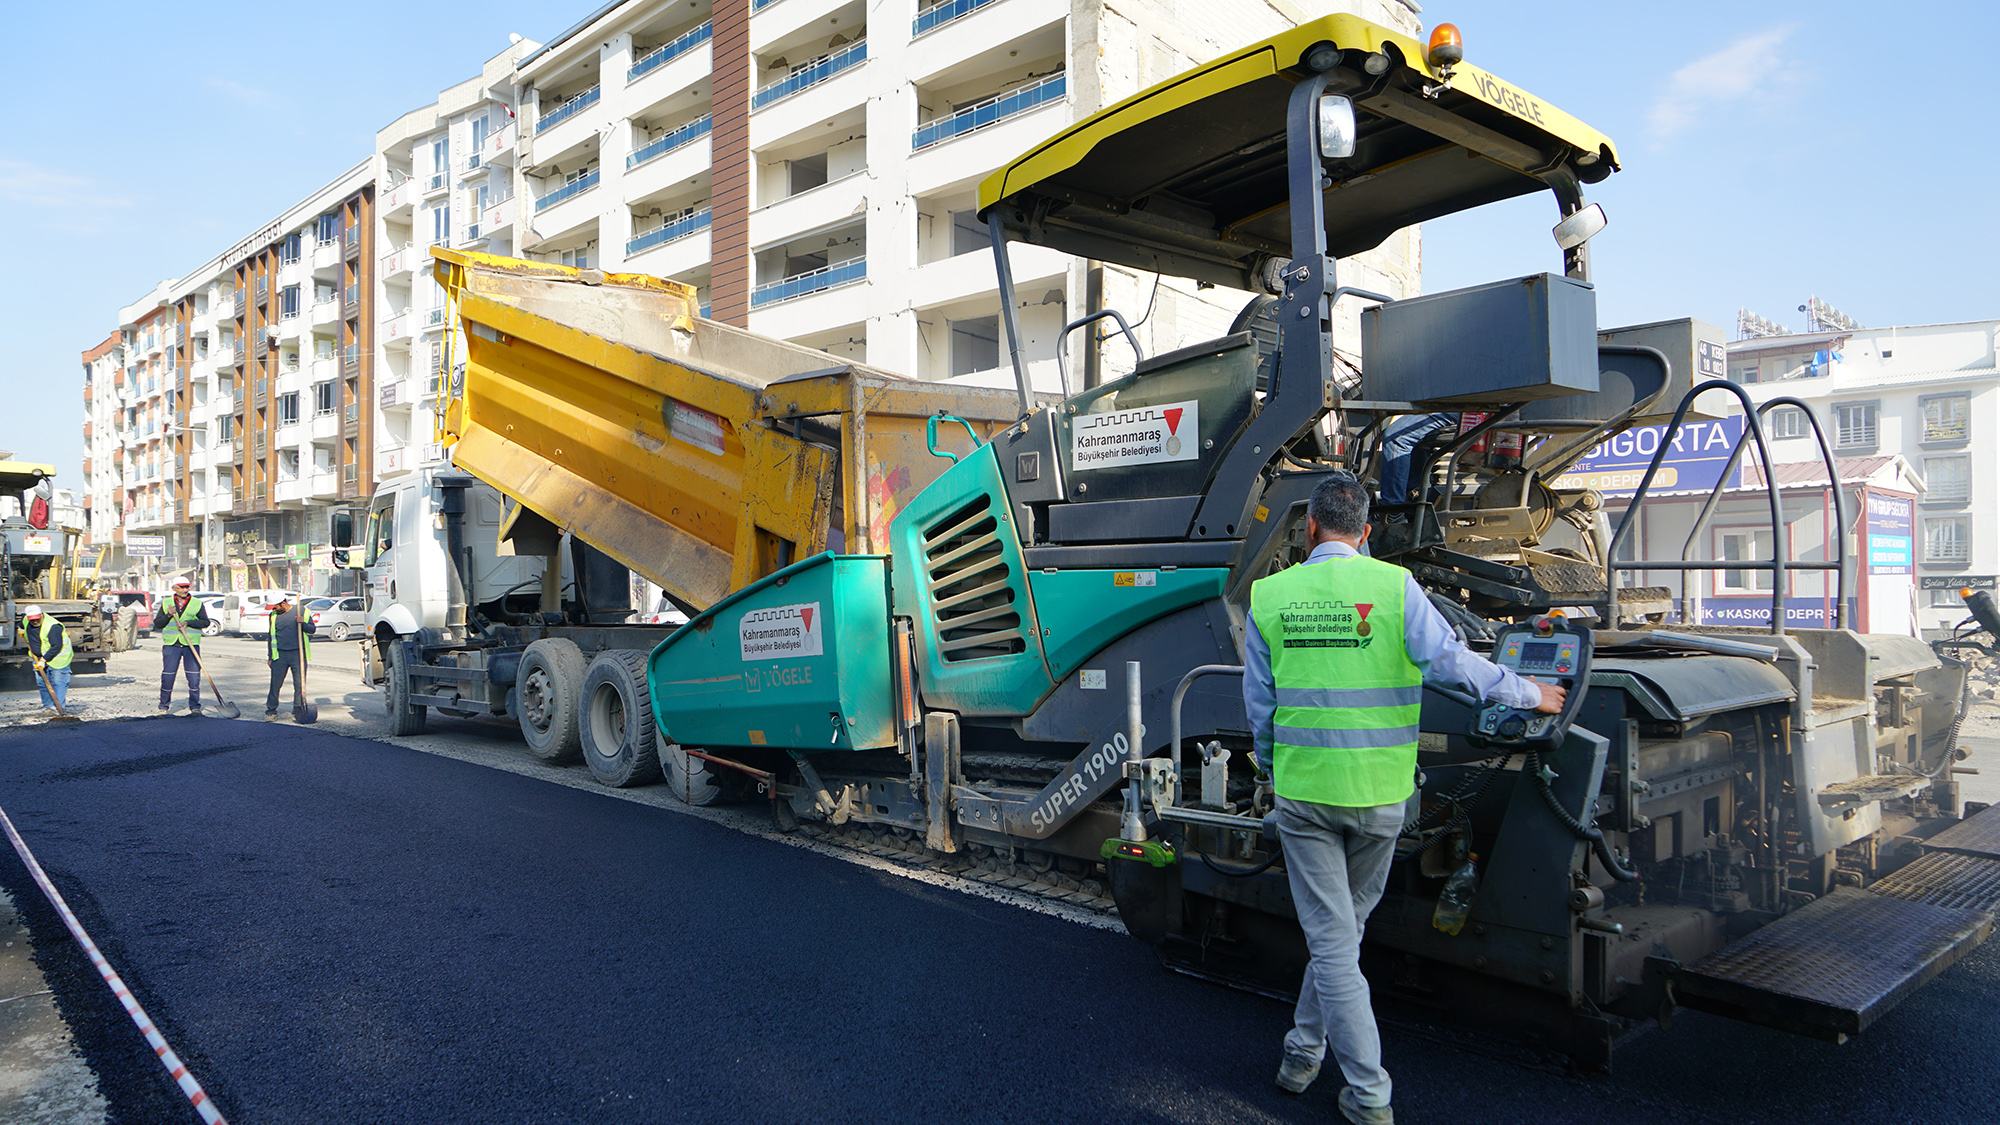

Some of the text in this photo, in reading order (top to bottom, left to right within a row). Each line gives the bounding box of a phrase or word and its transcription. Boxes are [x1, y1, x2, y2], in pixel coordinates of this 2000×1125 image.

[1472, 73, 1544, 125] VÖGELE
[1077, 430, 1161, 448] Kahramanmaraş
[1077, 444, 1162, 462] Büyükşehir Belediyesi
[1601, 472, 1666, 488] DEPRM
[1280, 612, 1352, 623] Kahramanmaraş
[1726, 608, 1771, 619] KASKO
[1786, 609, 1838, 619] DEPRE
[743, 627, 800, 640] Kahramanmaraş
[1318, 624, 1353, 635] Belediyesi
[744, 640, 801, 654] Büyükşehir Belediyesi
[763, 665, 812, 687] VÖGELE
[1030, 724, 1147, 834] SUPER 1900
